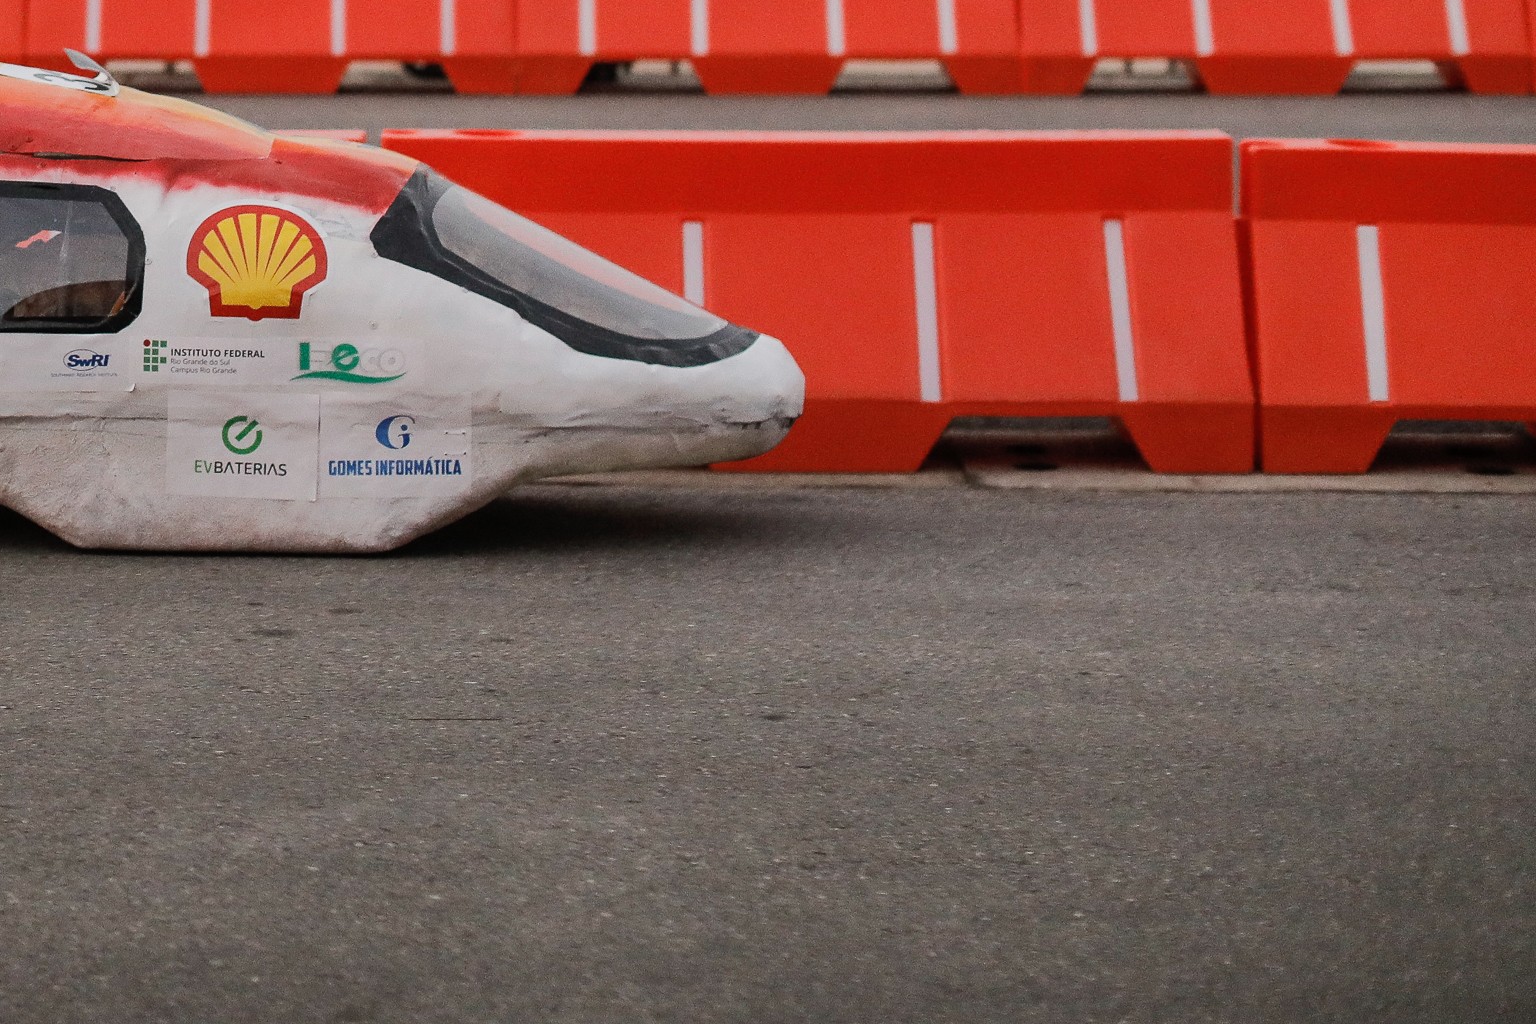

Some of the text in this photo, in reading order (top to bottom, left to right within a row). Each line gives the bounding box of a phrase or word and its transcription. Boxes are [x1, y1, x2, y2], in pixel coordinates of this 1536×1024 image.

[66, 353, 110, 368] SwRI
[170, 348, 265, 358] INSTITUTO FEDERAL
[170, 366, 199, 374] Campus
[194, 460, 287, 476] EVBATERIAS
[328, 456, 462, 476] GOMES INFORMÁTICA
